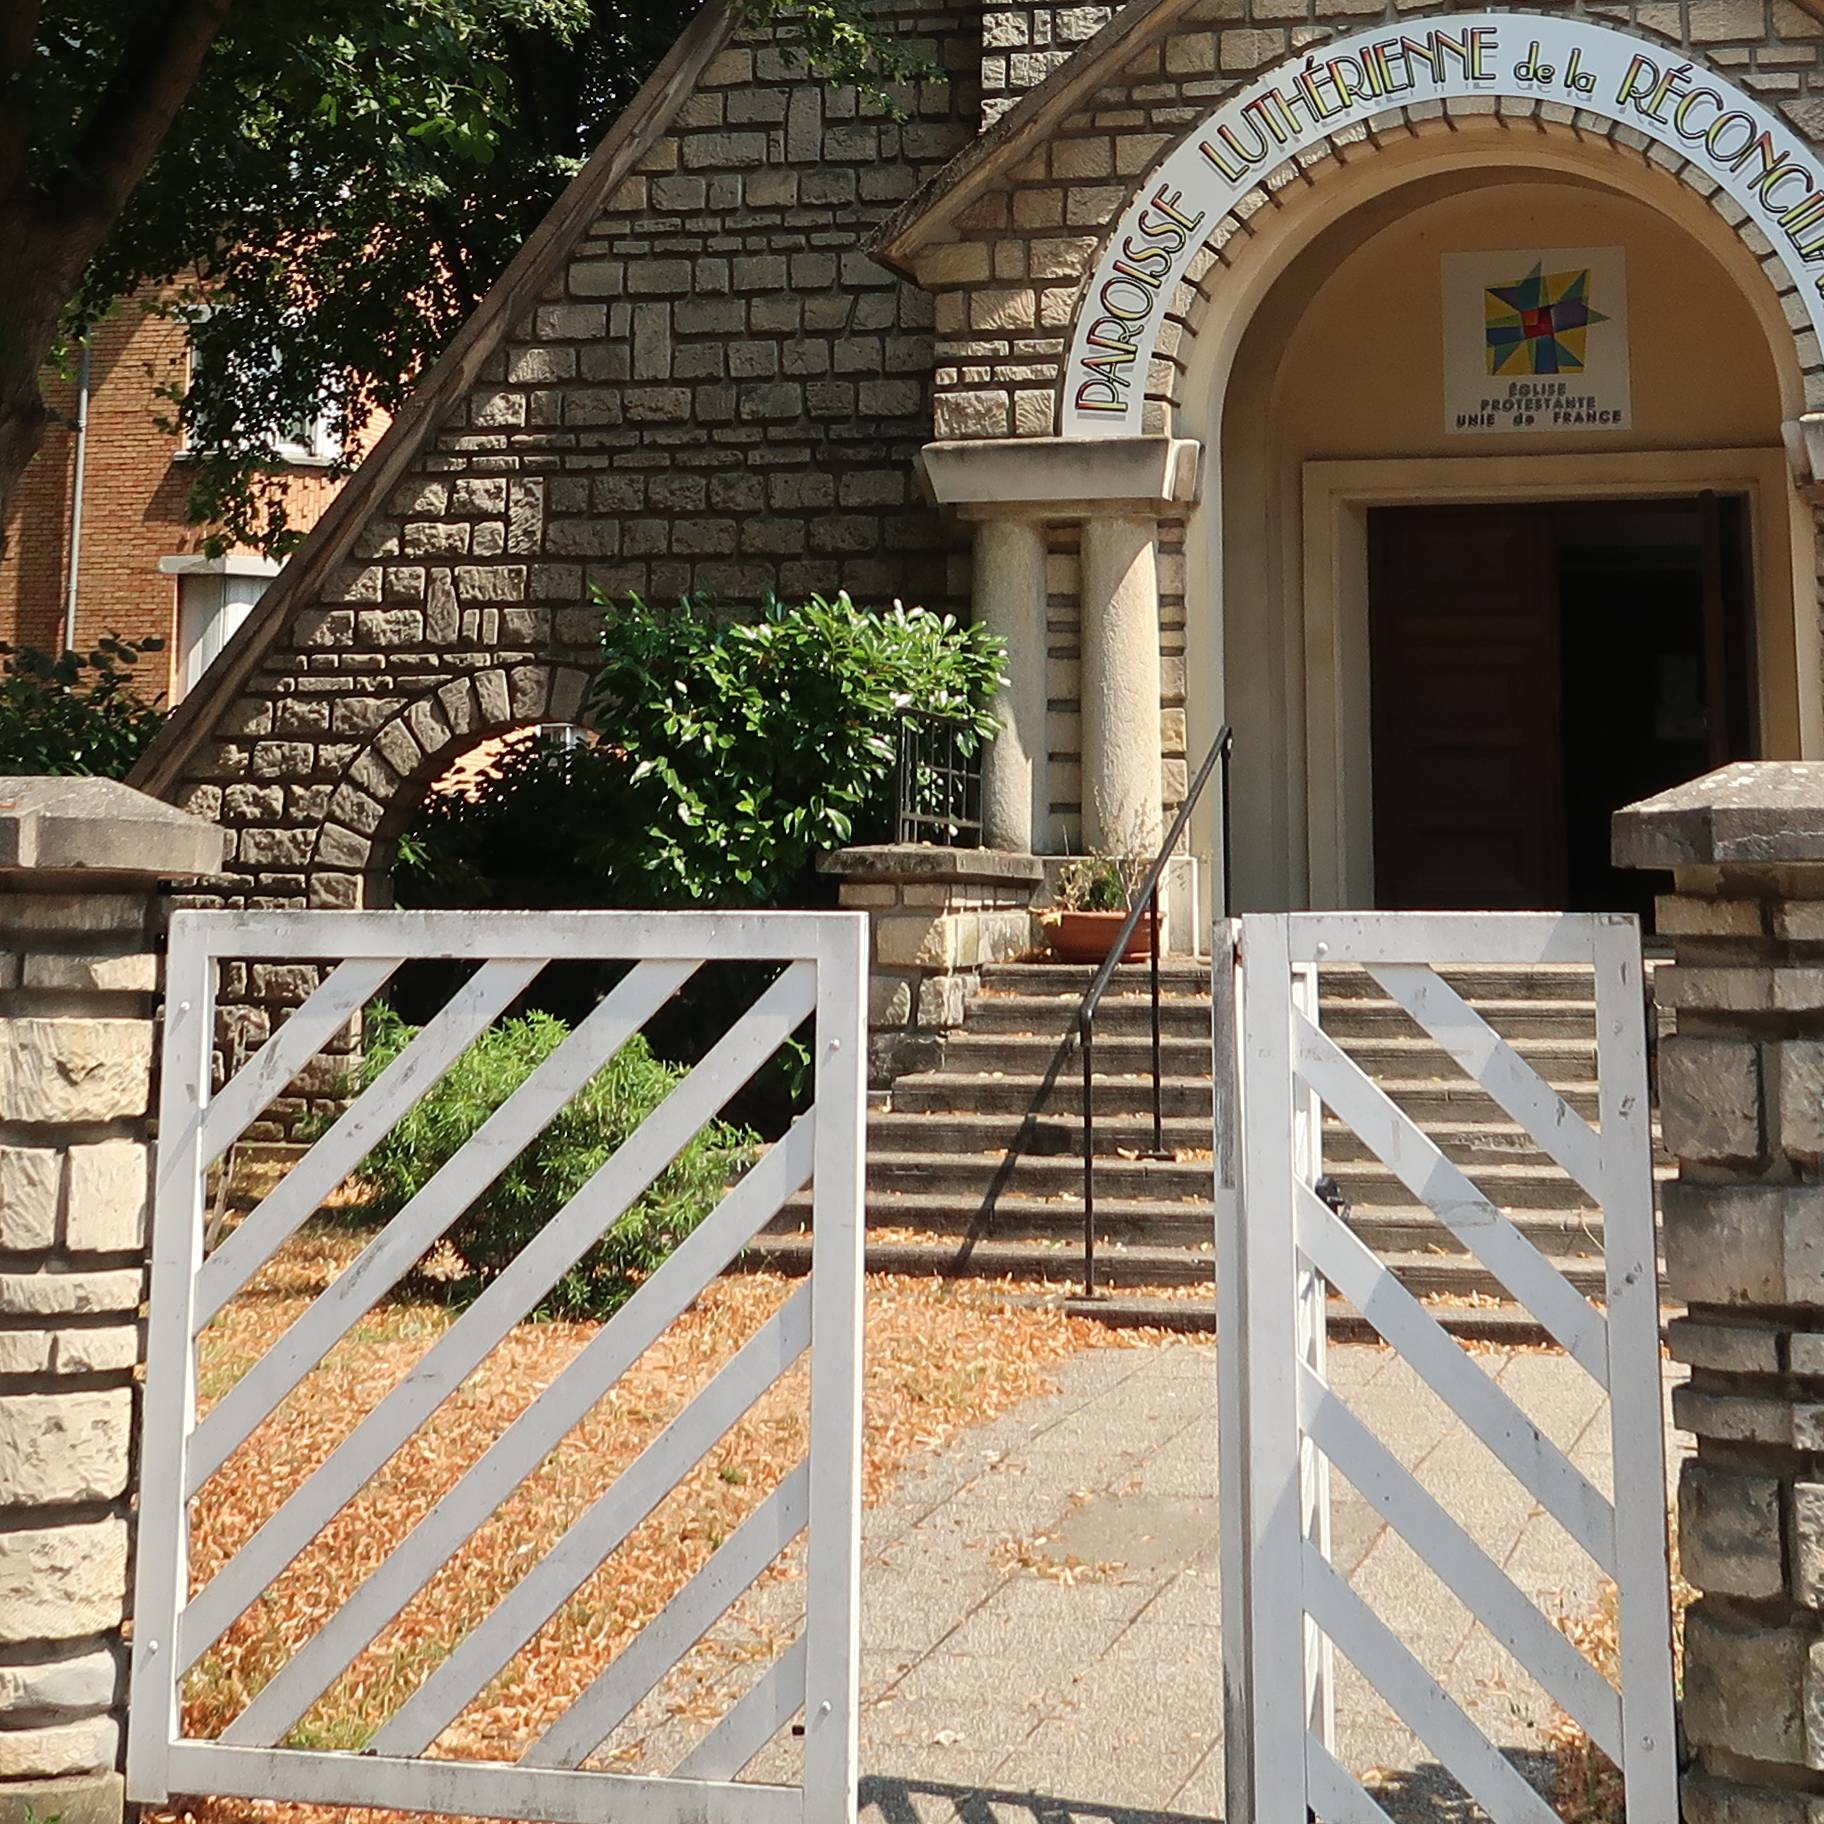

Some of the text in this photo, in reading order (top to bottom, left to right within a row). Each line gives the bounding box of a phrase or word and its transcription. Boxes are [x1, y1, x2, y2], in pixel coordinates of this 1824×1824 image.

[1075, 183, 1205, 412] PAROISSE
[1199, 27, 1498, 182] LUTHÉRIENNE
[1514, 40, 1556, 84] de
[1565, 48, 1597, 94] la
[1508, 382, 1567, 398] ÉGLISE
[1480, 396, 1596, 413] PROTESTANTE
[1456, 410, 1622, 428] UNIE de FRANCE
